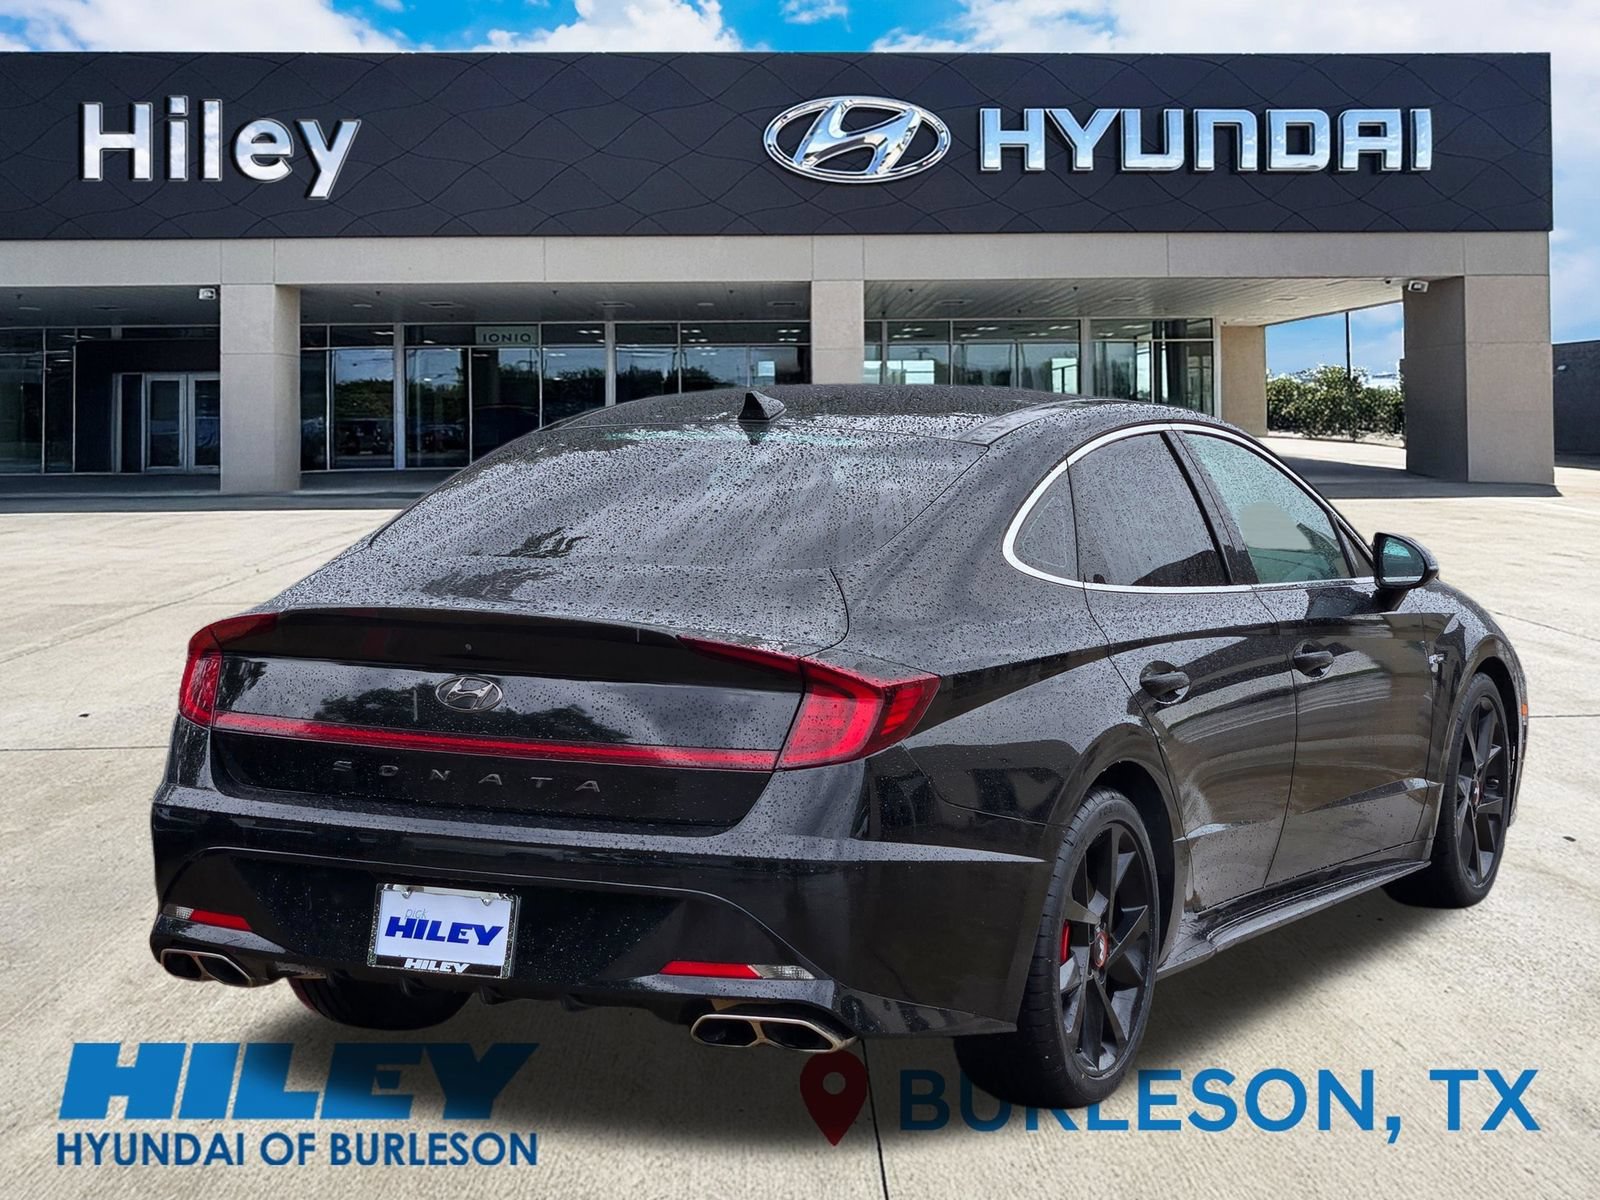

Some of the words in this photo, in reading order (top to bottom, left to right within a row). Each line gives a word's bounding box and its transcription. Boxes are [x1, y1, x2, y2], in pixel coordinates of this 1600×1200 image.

[79, 95, 361, 200] Hiley
[979, 107, 1433, 172] HYUNDAI
[332, 760, 601, 793] SONATA
[404, 907, 428, 920] pick
[385, 916, 503, 946] HILEY
[404, 958, 471, 973] HILEY
